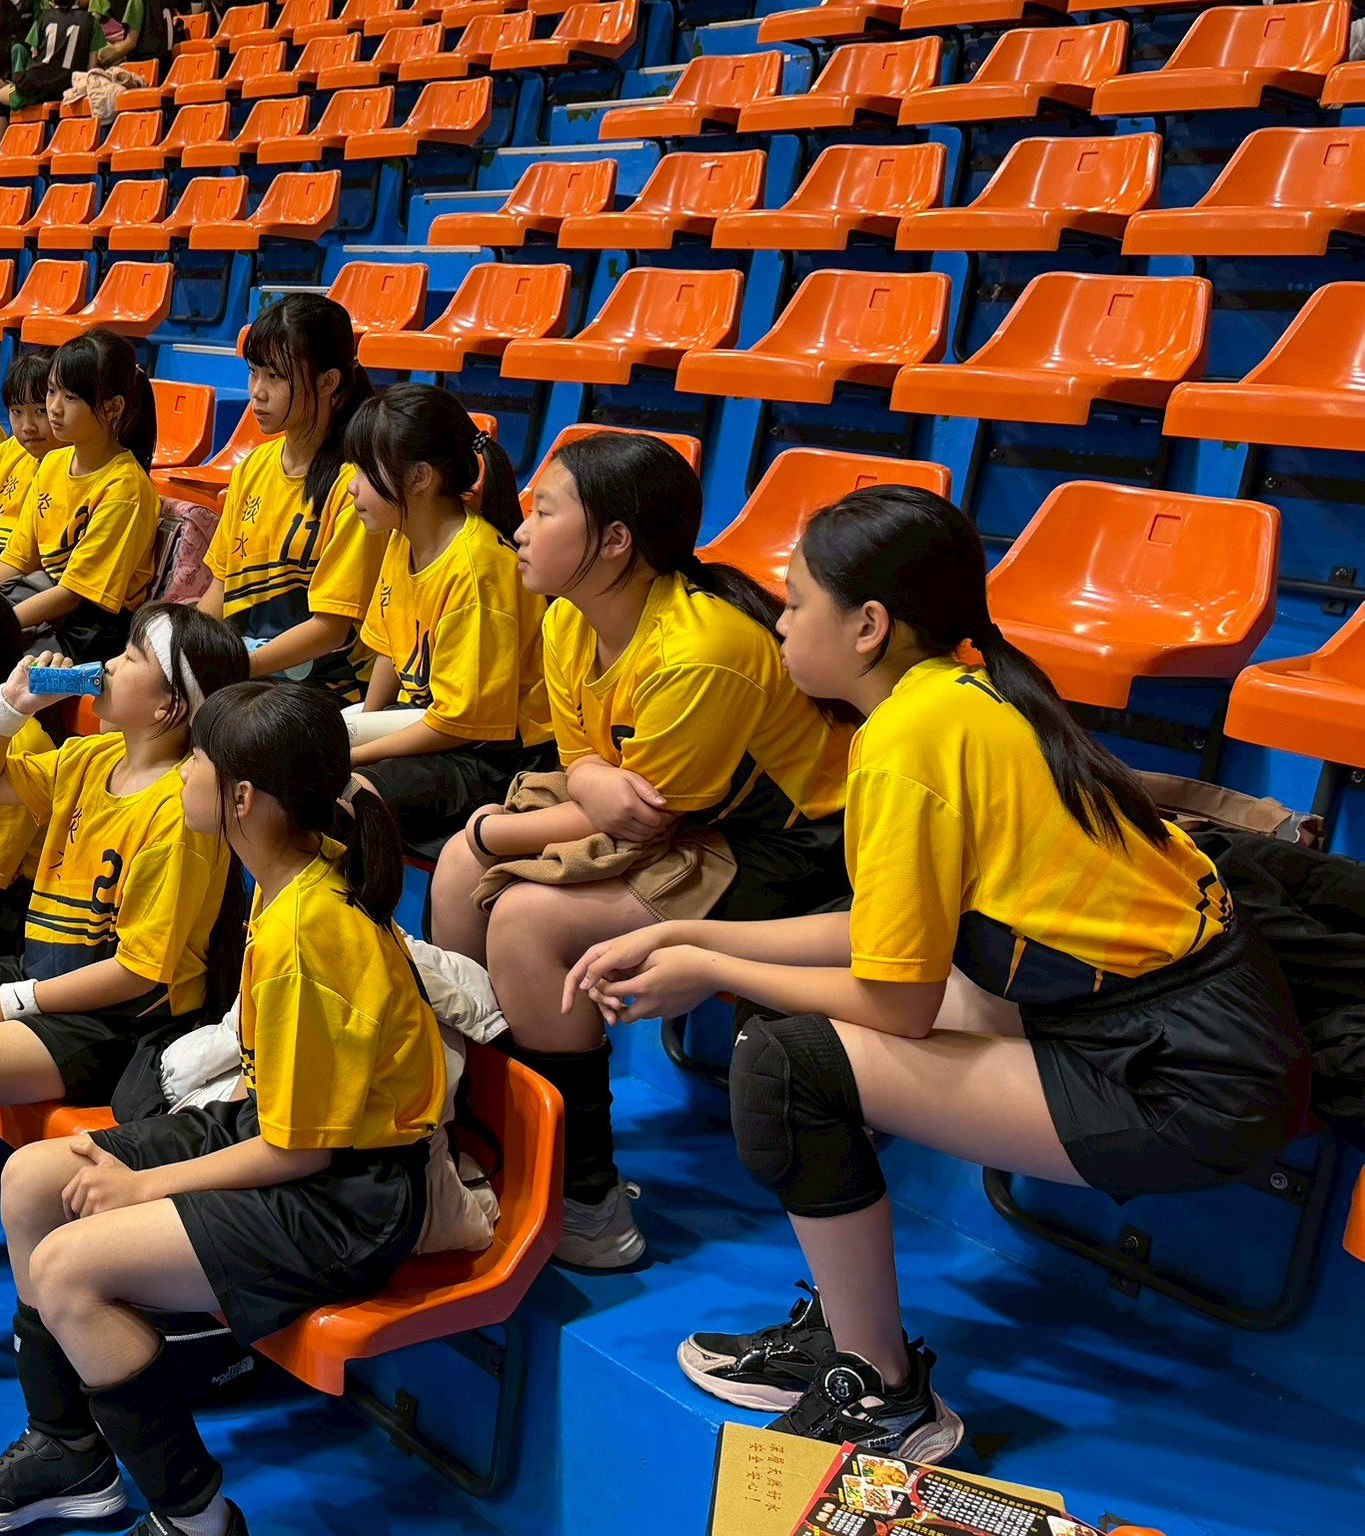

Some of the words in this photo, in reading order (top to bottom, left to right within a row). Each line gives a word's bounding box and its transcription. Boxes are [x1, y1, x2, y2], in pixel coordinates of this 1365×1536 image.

[41, 22, 81, 70] 11
[231, 494, 263, 560] 淡水
[279, 512, 321, 570] 11
[90, 848, 124, 914] 2
